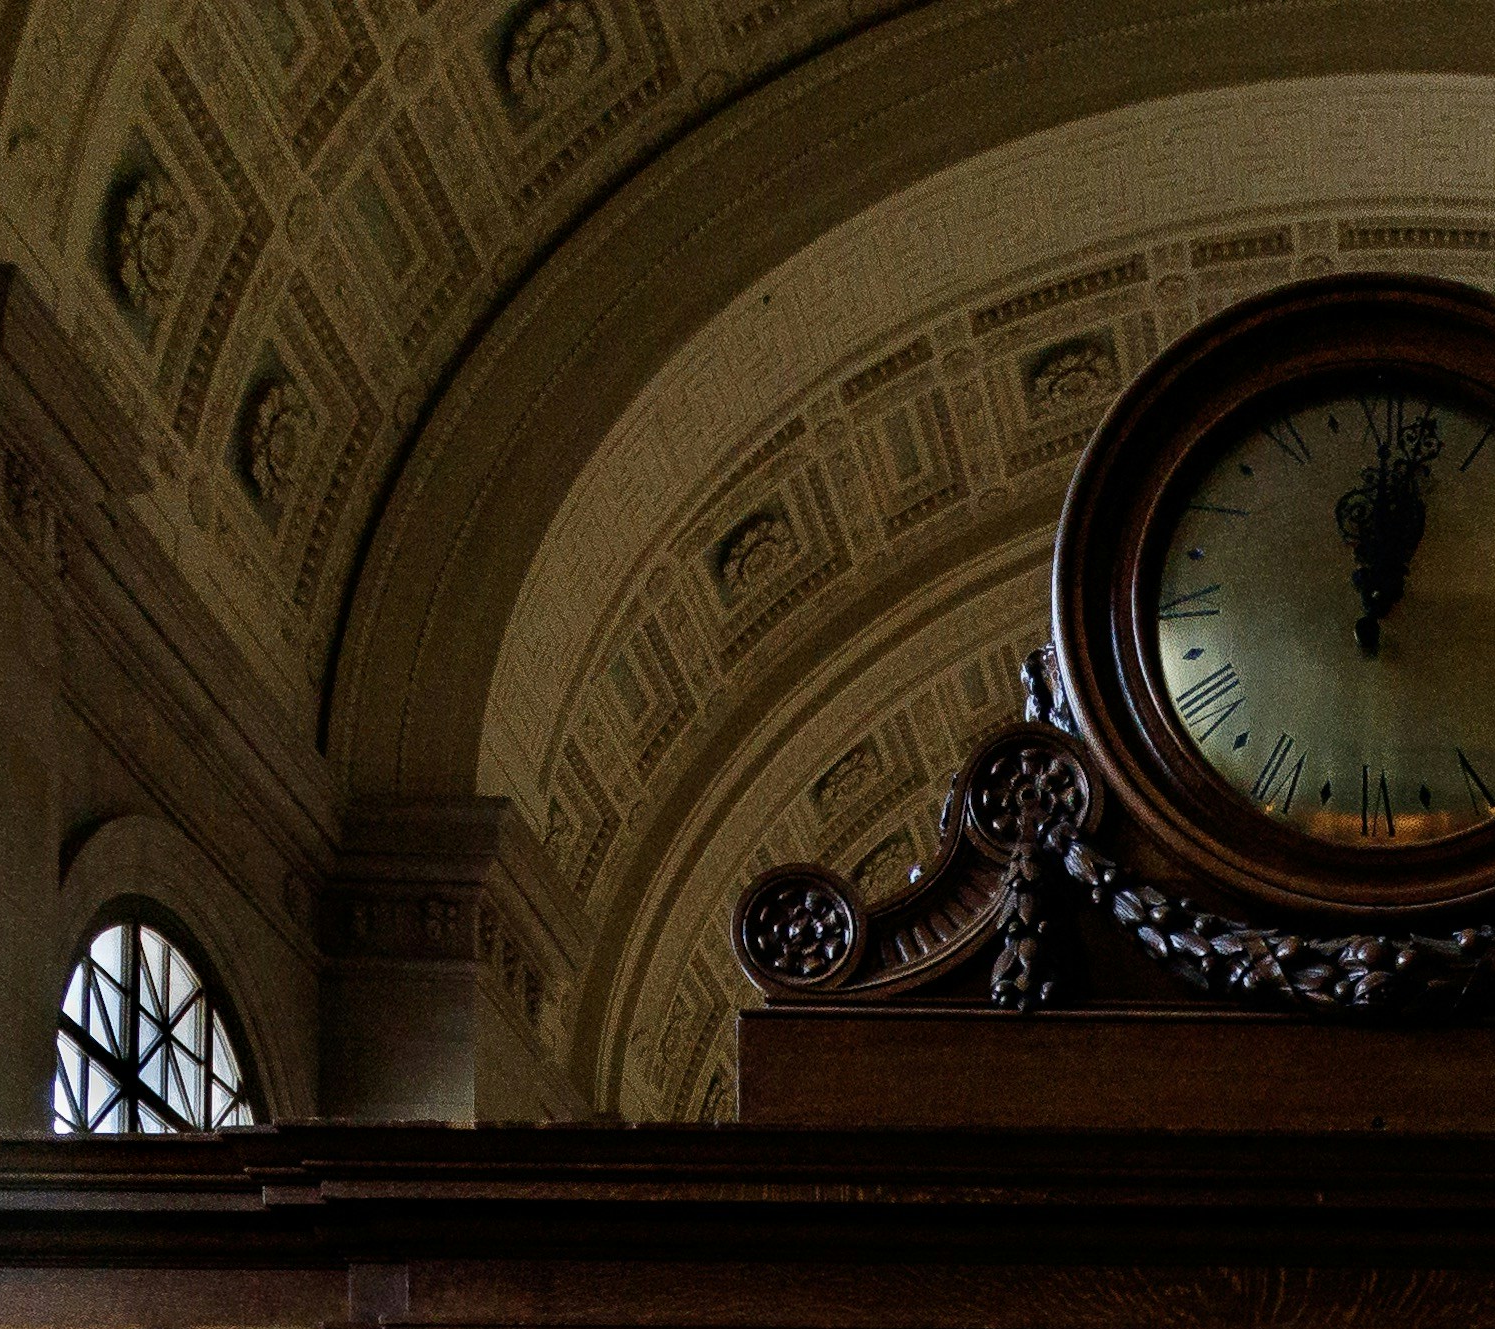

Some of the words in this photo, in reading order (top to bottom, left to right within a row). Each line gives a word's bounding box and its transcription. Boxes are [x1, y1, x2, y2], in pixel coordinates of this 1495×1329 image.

[1176, 662, 1245, 744] VIII
[1250, 733, 1308, 816] VII
[1361, 764, 1396, 837] VI
